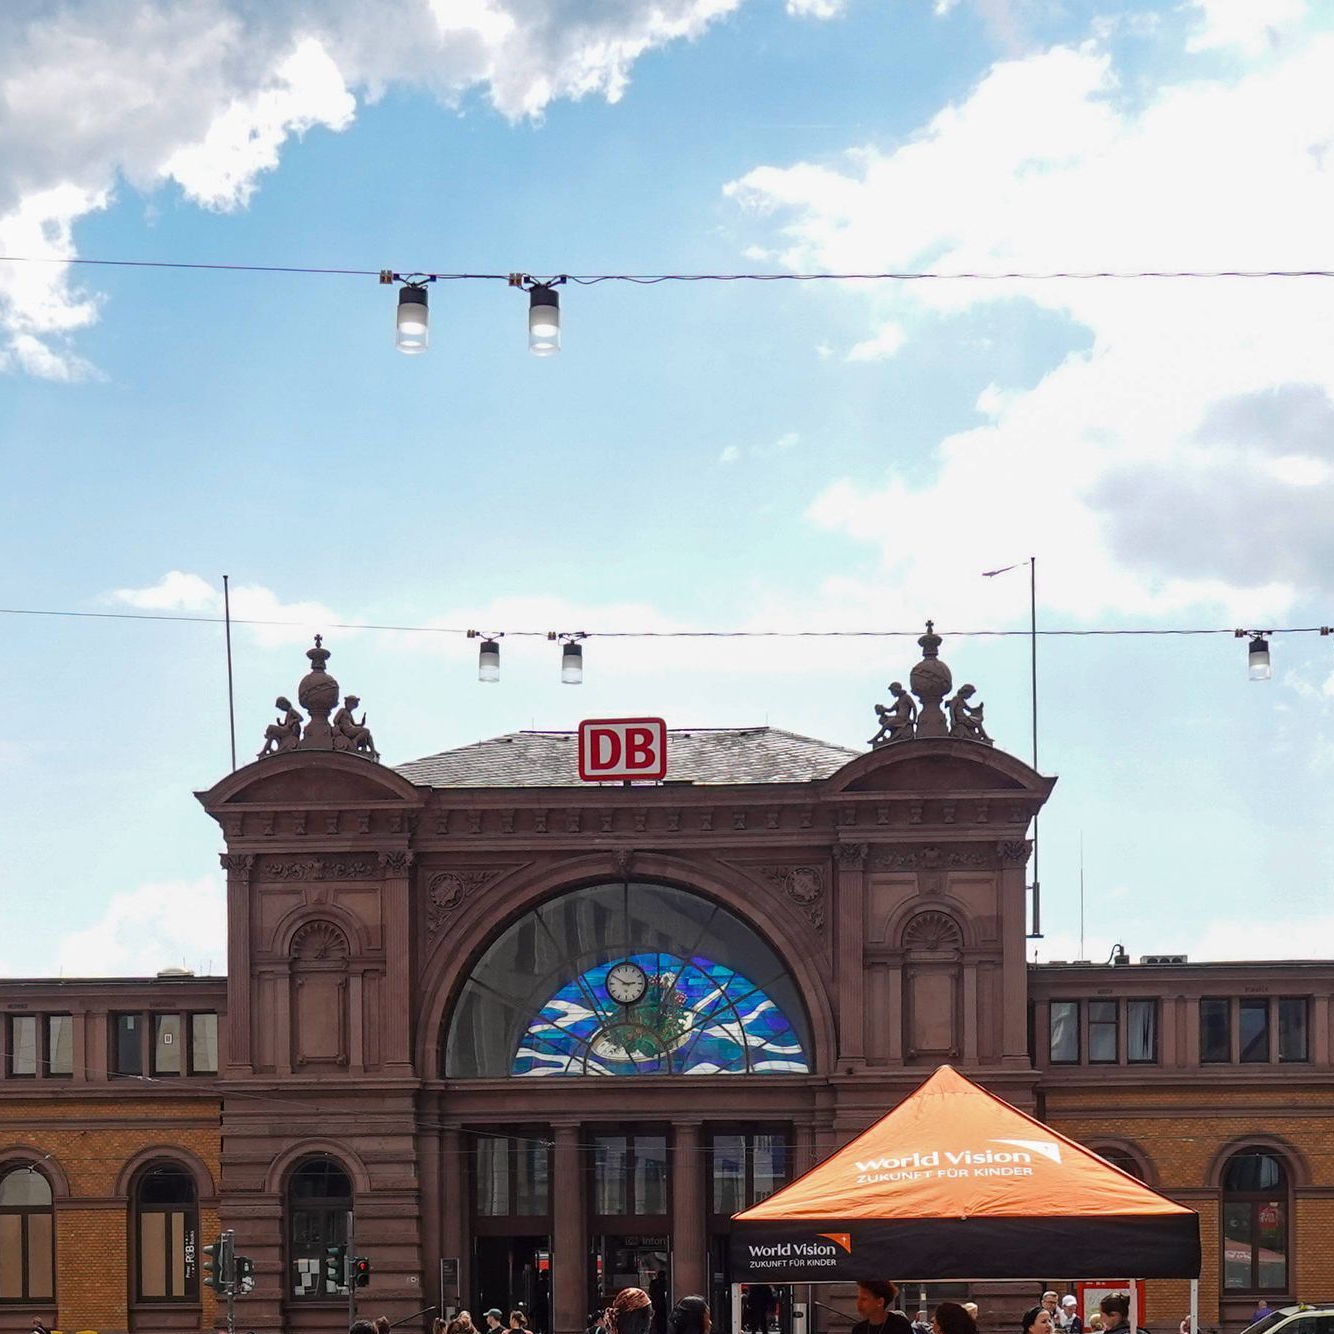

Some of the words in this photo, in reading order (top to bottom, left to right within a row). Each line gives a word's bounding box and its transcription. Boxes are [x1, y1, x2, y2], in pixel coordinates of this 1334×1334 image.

[590, 727, 656, 771] DB
[855, 1151, 939, 1171] World
[945, 1148, 1031, 1165] Vision
[856, 1170, 934, 1184] ZUKUNFT
[938, 1167, 968, 1178] FÜR
[973, 1166, 1034, 1177] KINDER
[748, 1243, 791, 1257] World
[793, 1242, 836, 1256] Vision
[749, 1259, 787, 1269] ZUKUNFT
[789, 1257, 805, 1268] FÜR
[807, 1258, 837, 1267] KINDER
